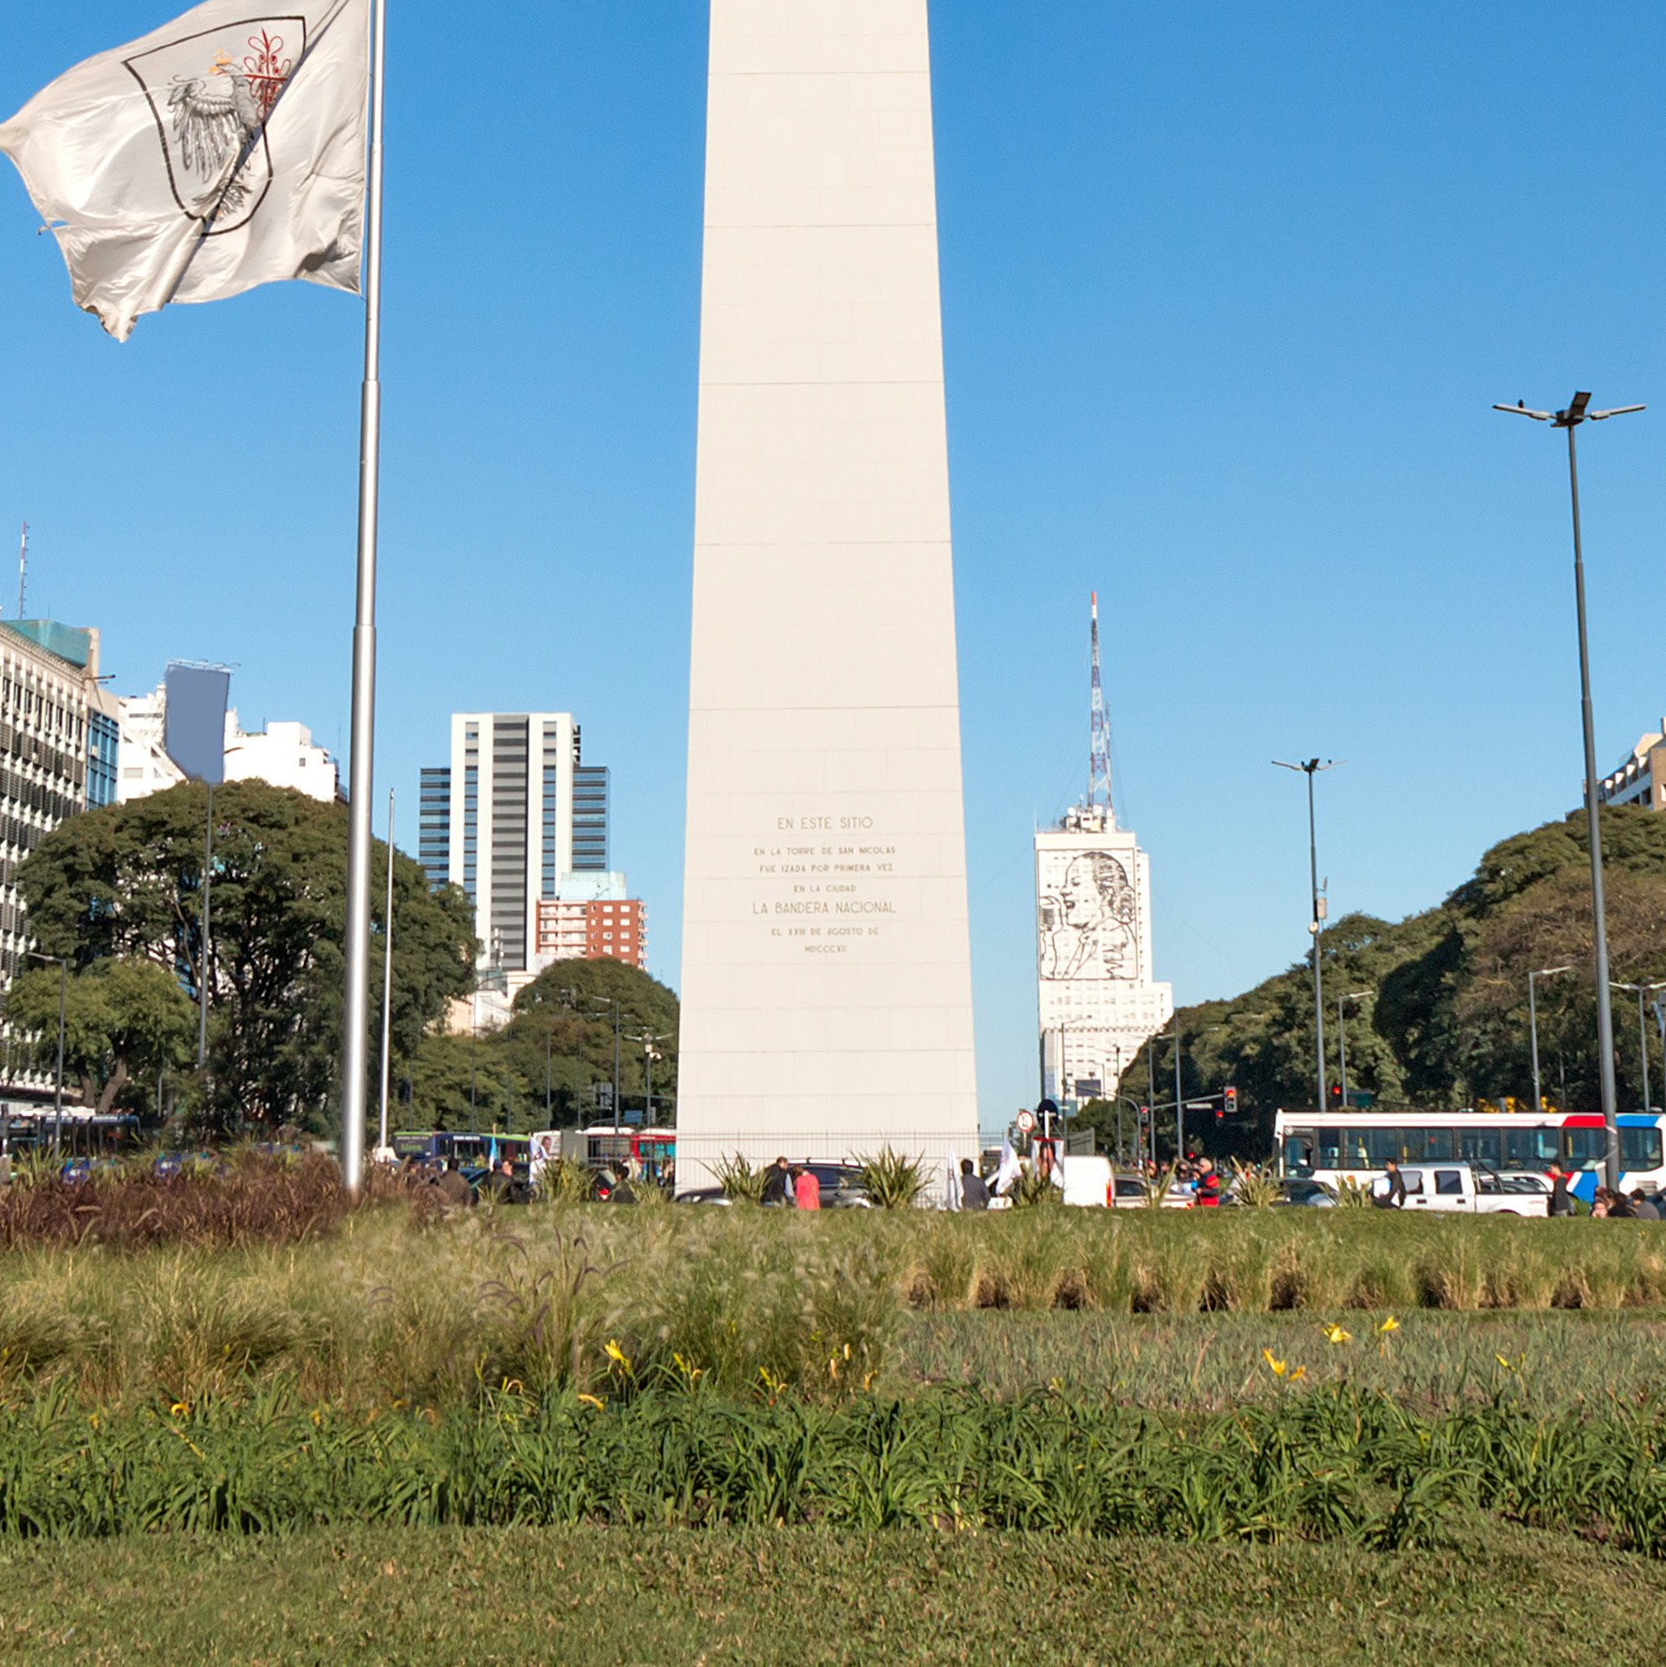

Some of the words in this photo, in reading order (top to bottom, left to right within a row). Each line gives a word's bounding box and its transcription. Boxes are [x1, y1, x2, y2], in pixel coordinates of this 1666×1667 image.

[777, 817, 793, 830] EN
[801, 817, 832, 829] ESTE
[840, 816, 873, 829] SITIO
[822, 847, 832, 855] DE
[760, 865, 775, 873] FUE
[811, 864, 829, 872] POR
[877, 863, 893, 871] VEZ
[753, 903, 768, 914] LA
[775, 902, 829, 914] BANDERA
[836, 901, 896, 913] NACIONAL
[868, 927, 879, 935] DE
